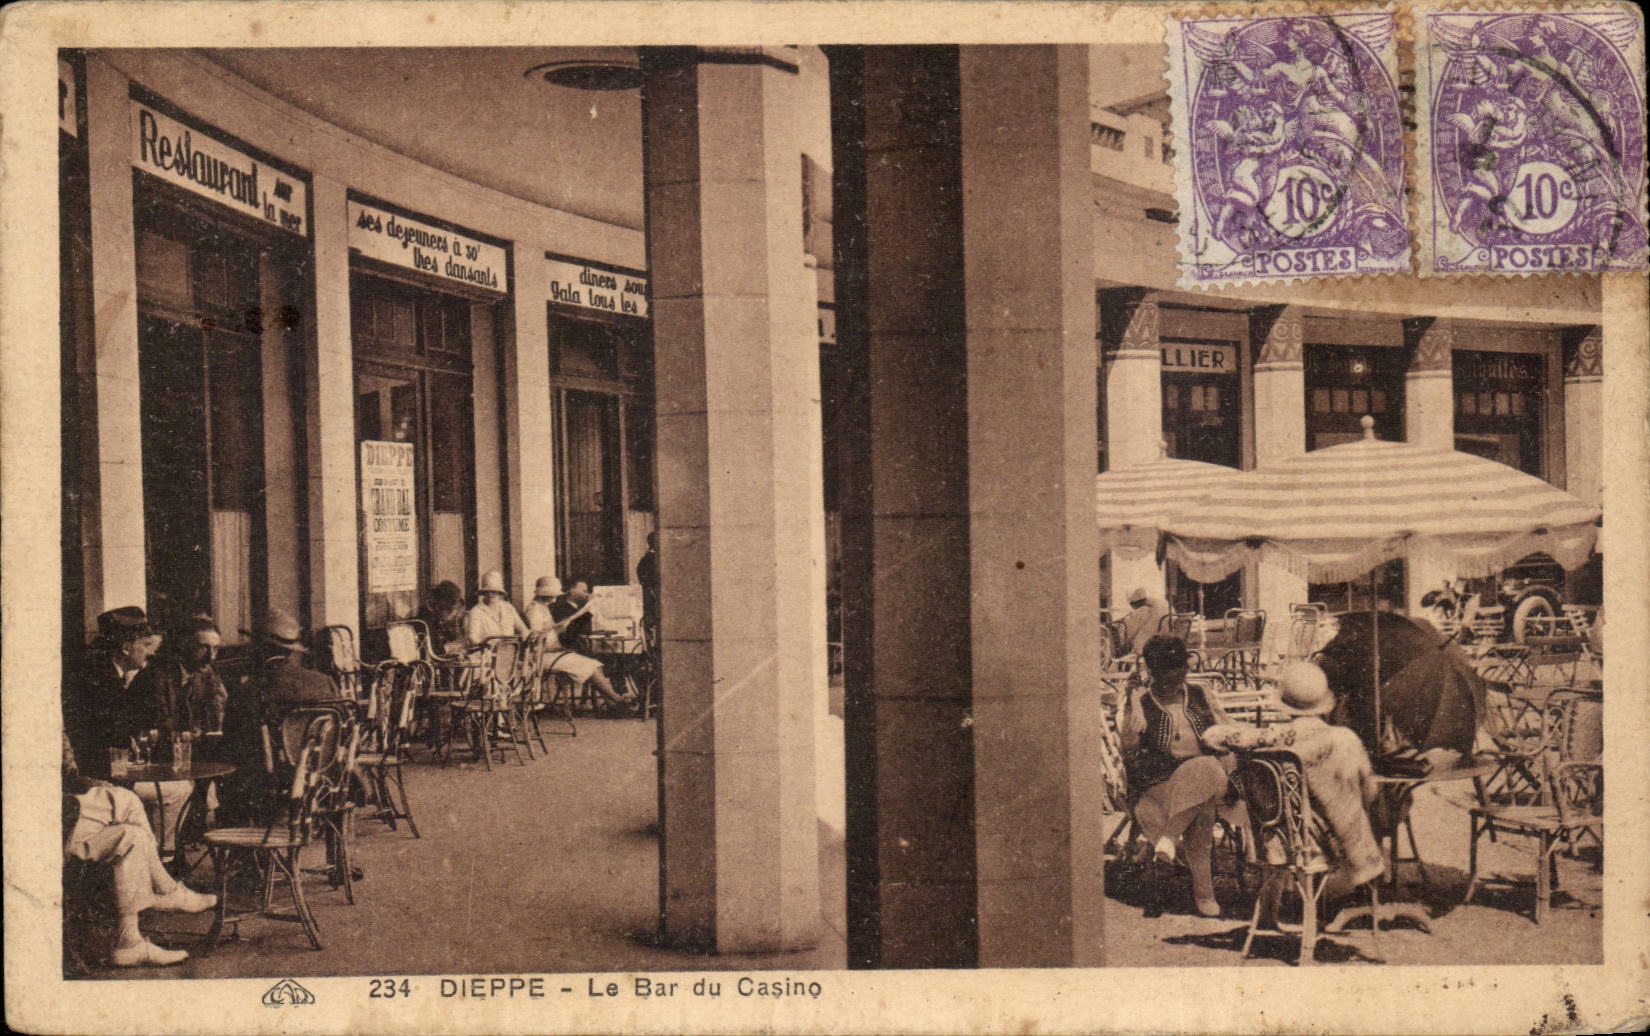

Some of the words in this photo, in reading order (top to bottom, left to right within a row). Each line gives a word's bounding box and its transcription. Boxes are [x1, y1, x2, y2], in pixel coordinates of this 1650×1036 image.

[140, 109, 260, 209] Restaurant
[357, 209, 382, 234] ses
[1256, 249, 1352, 275] POSTES
[1494, 246, 1588, 270] POSTES
[366, 444, 413, 467] DIEPPE
